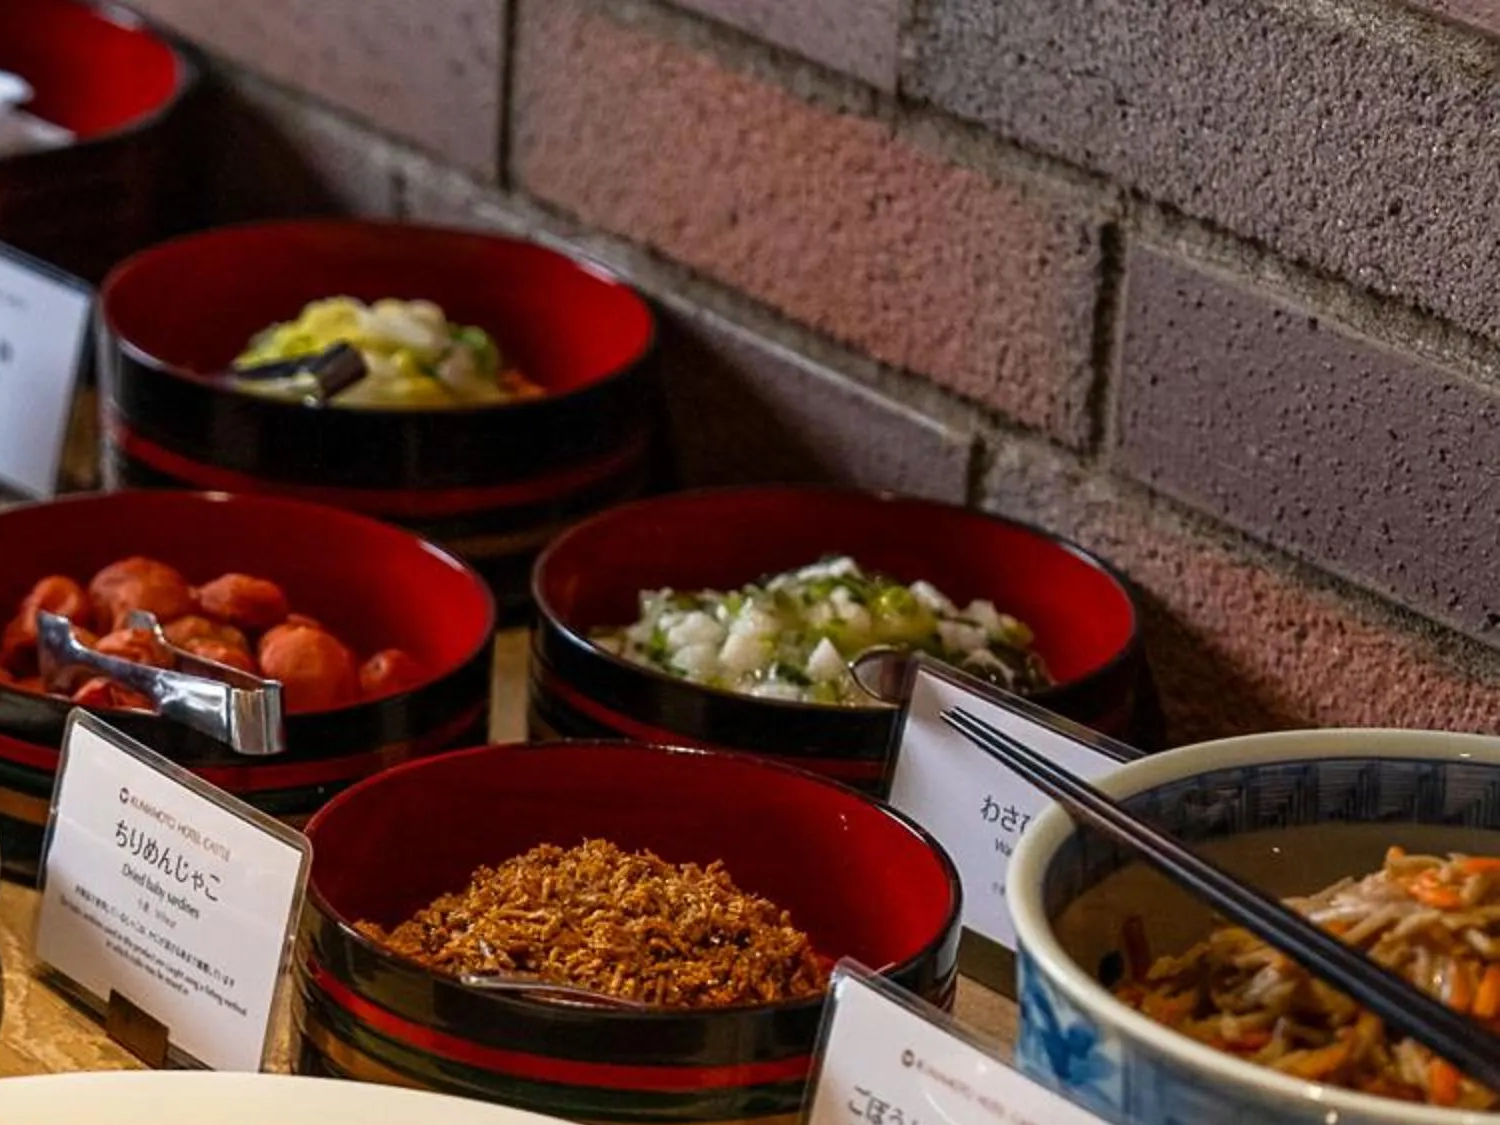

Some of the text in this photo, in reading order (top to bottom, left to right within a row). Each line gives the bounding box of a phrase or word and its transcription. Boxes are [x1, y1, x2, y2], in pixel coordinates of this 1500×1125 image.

[115, 819, 222, 902] ちりめんじゃこ
[122, 863, 145, 886] Dried
[145, 877, 166, 899] baby
[167, 891, 200, 919] sardines
